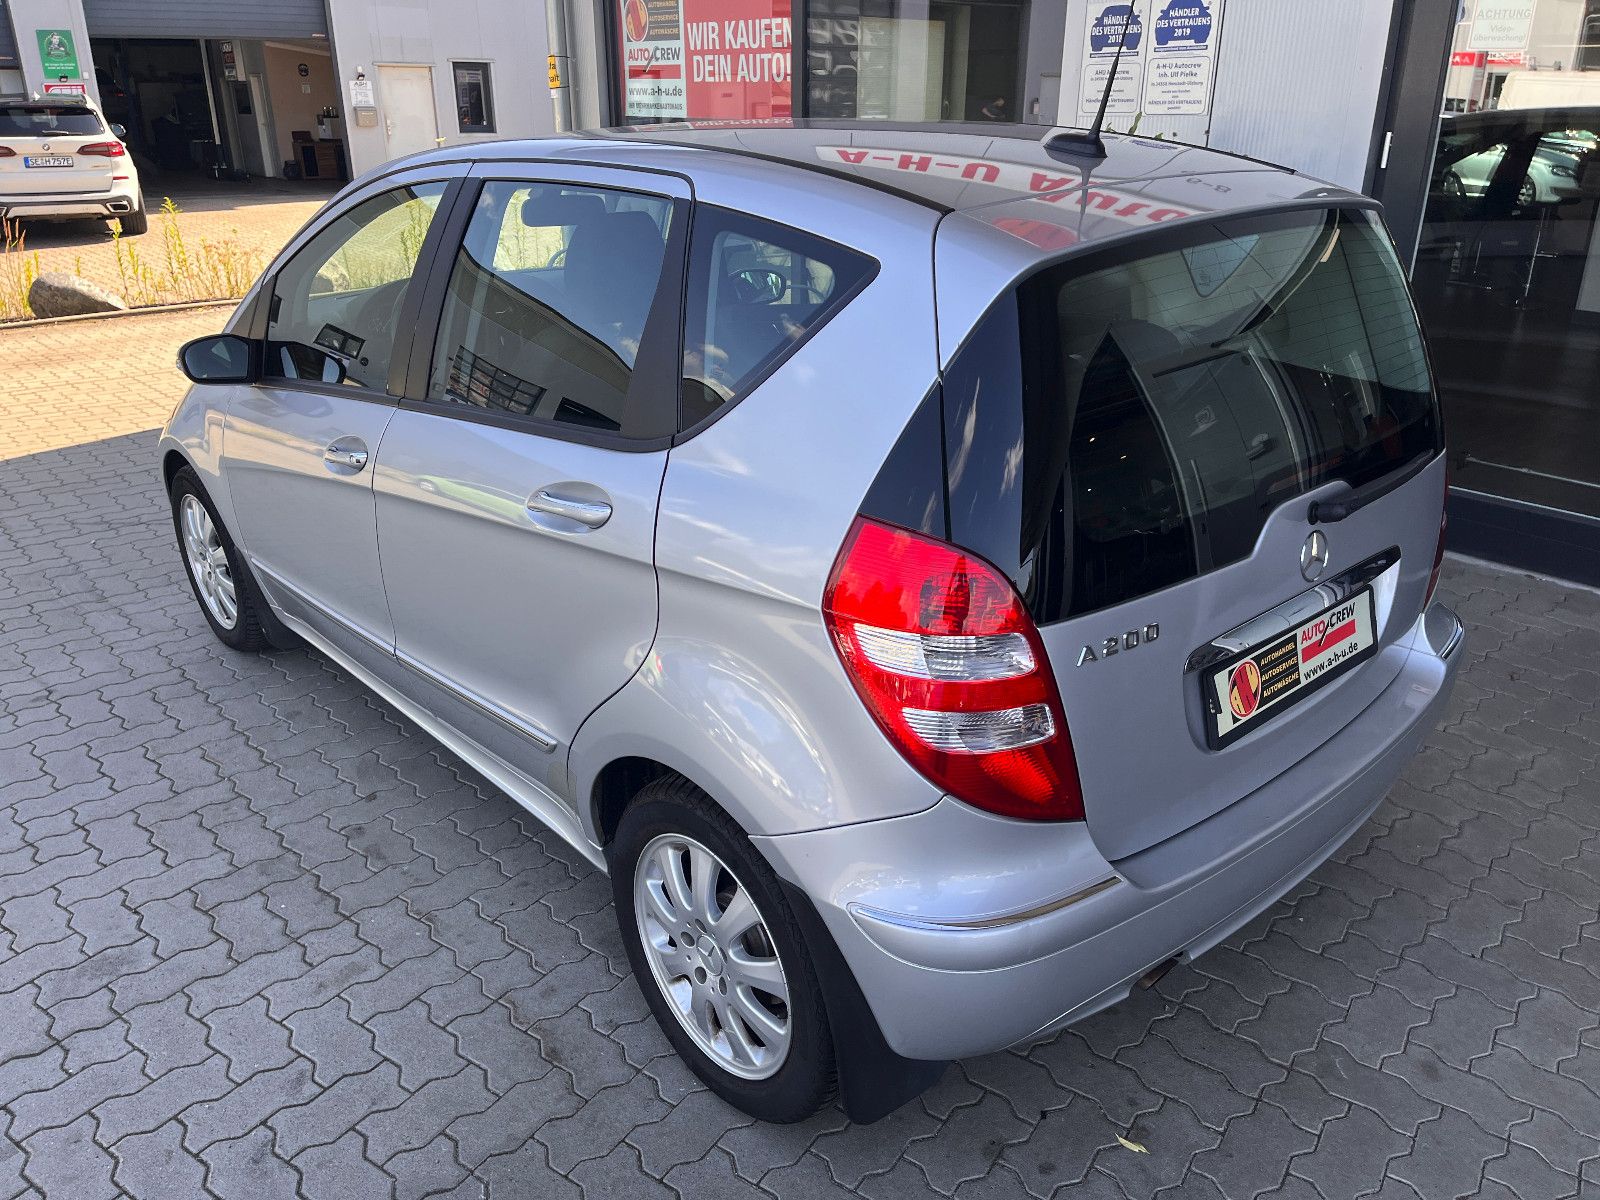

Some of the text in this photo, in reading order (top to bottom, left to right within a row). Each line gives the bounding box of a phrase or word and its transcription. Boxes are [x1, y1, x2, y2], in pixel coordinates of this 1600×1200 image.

[1170, 8, 1199, 17] HÄNDLER
[1477, 9, 1531, 18] ACHTUNG
[1092, 26, 1103, 35] DES
[1157, 17, 1211, 28] DES VERTRAUENS
[687, 17, 792, 50] WIR KAUFEN
[1174, 28, 1191, 37] 2019
[693, 52, 791, 82] DEIN AUTO!
[629, 86, 683, 97] www.a-h-u.de
[1076, 622, 1159, 667] A 200
[1260, 641, 1296, 667] AUTOHANDEL
[1303, 641, 1358, 681] www.a-h-u.de
[1261, 655, 1298, 682] AUTOSERVICE
